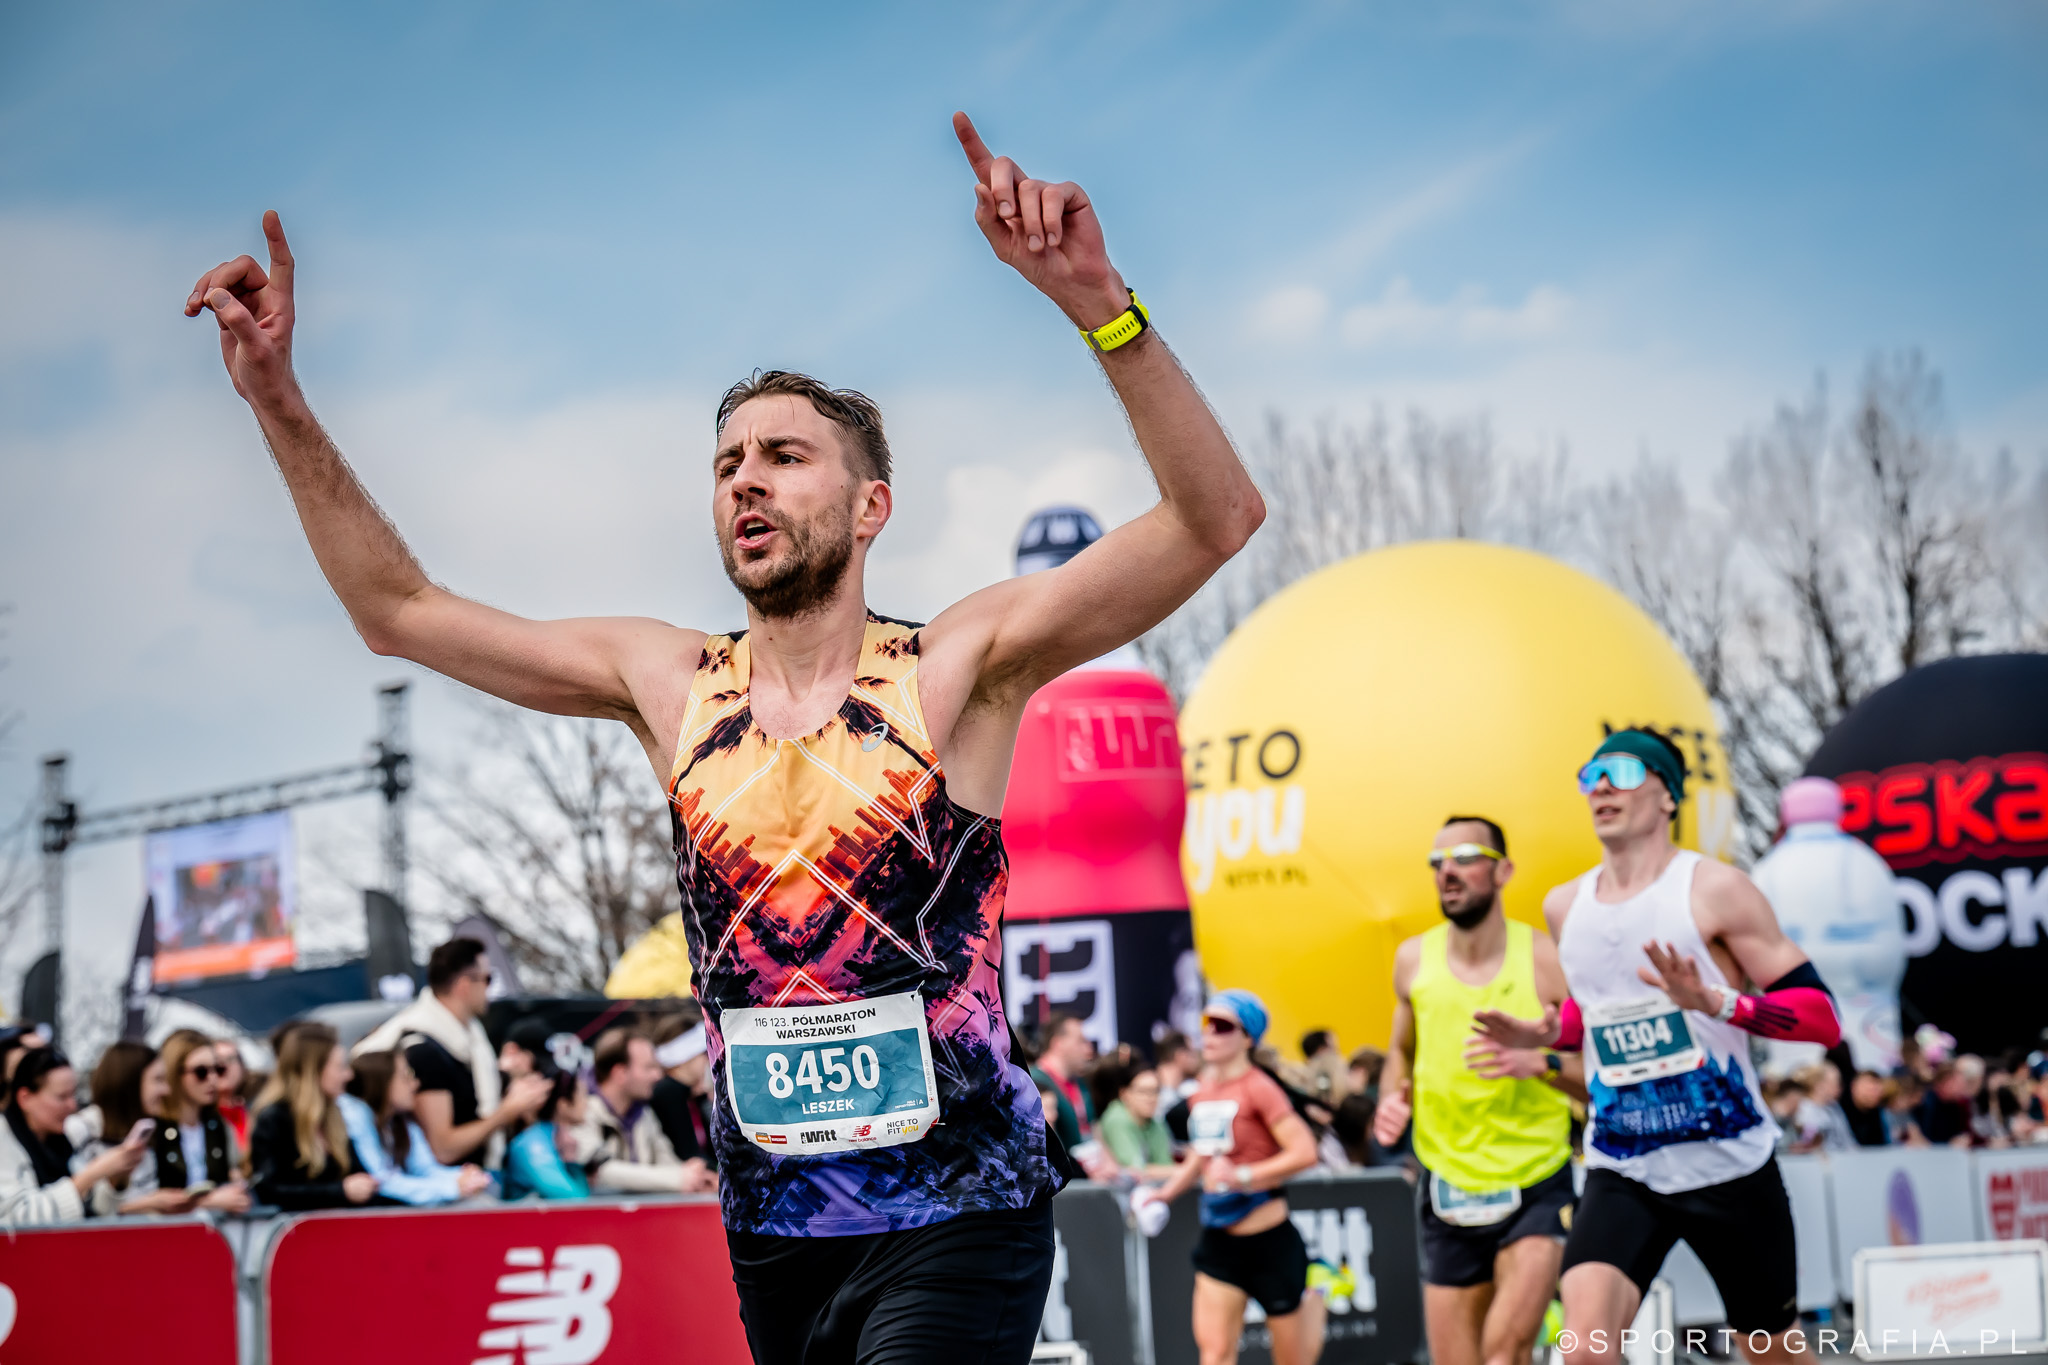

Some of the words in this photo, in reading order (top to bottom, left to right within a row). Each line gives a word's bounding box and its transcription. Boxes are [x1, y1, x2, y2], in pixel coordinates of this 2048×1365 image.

[1227, 729, 1302, 783] TO
[1185, 784, 1305, 896] you
[1895, 865, 2048, 959] OCK
[754, 1017, 768, 1028] 116
[792, 1007, 876, 1027] PÓŁMARATON
[776, 1023, 857, 1040] WARSZAWSKI
[1602, 1015, 1673, 1055] 11304
[766, 1044, 880, 1098] 8450
[801, 1098, 855, 1115] LESZEK
[886, 1119, 906, 1128] NICE
[887, 1128, 901, 1136] FIT
[901, 1125, 919, 1136] you
[804, 1129, 837, 1144] Witt
